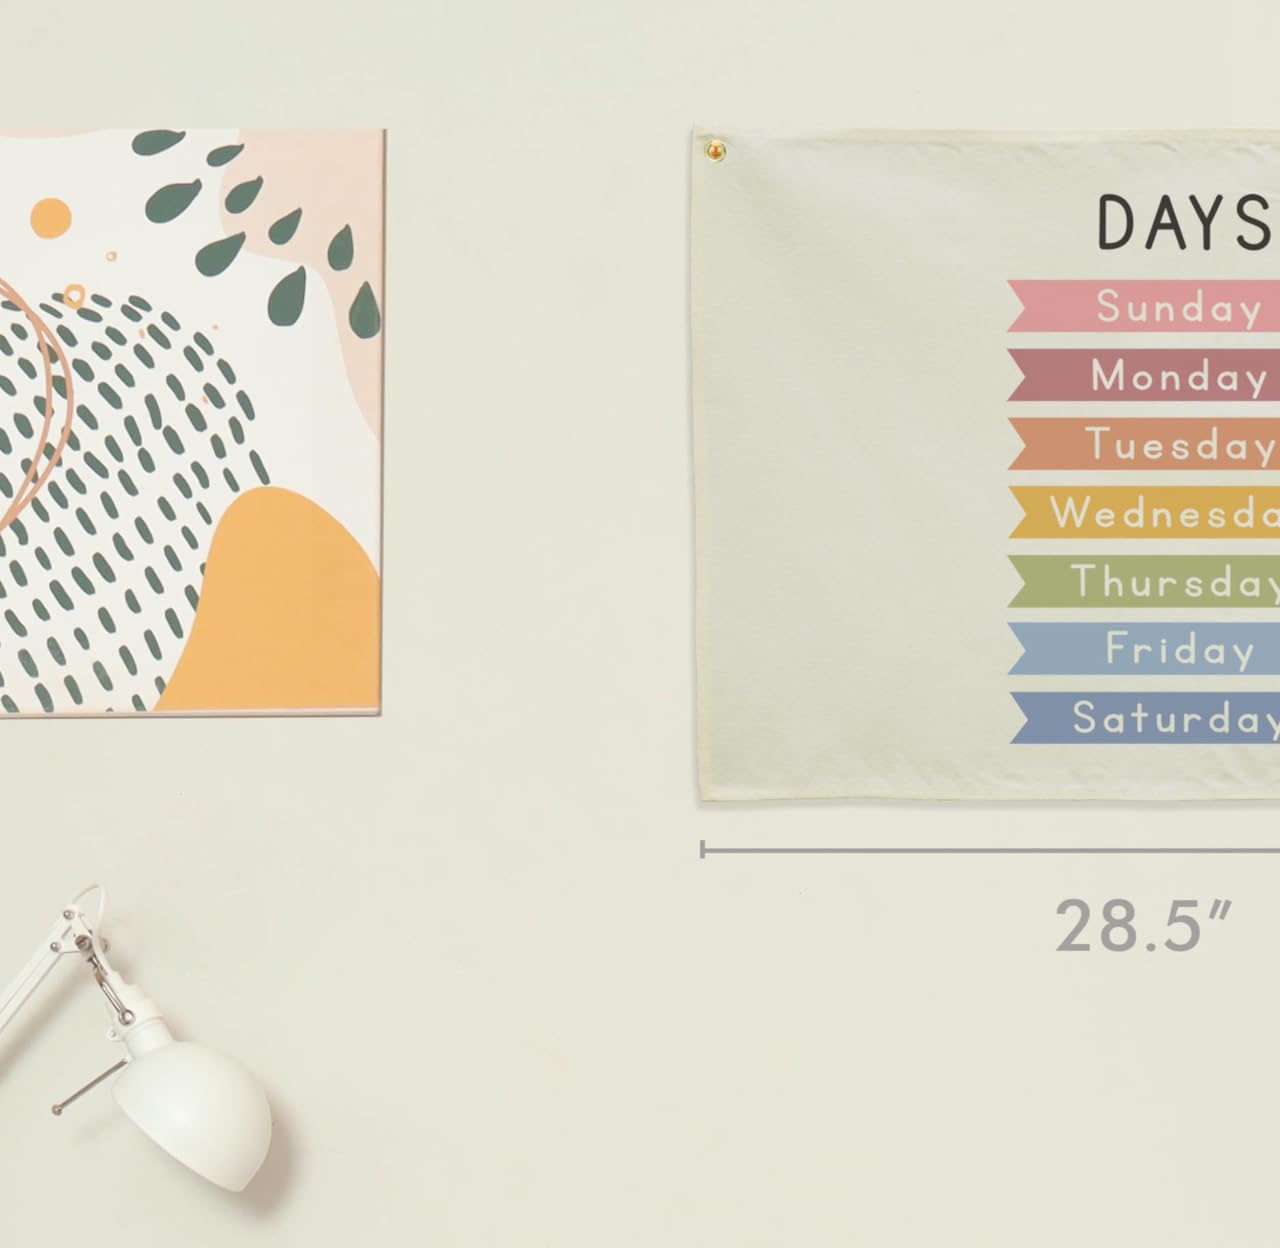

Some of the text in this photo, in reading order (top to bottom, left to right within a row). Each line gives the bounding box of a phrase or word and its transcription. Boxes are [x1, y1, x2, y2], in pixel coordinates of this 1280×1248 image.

[1099, 193, 1271, 251] DAYS
[1098, 289, 1261, 330] Sunday
[1093, 358, 1267, 399] Monday
[1085, 427, 1276, 468] Tuesday
[1108, 631, 1254, 672] Friday
